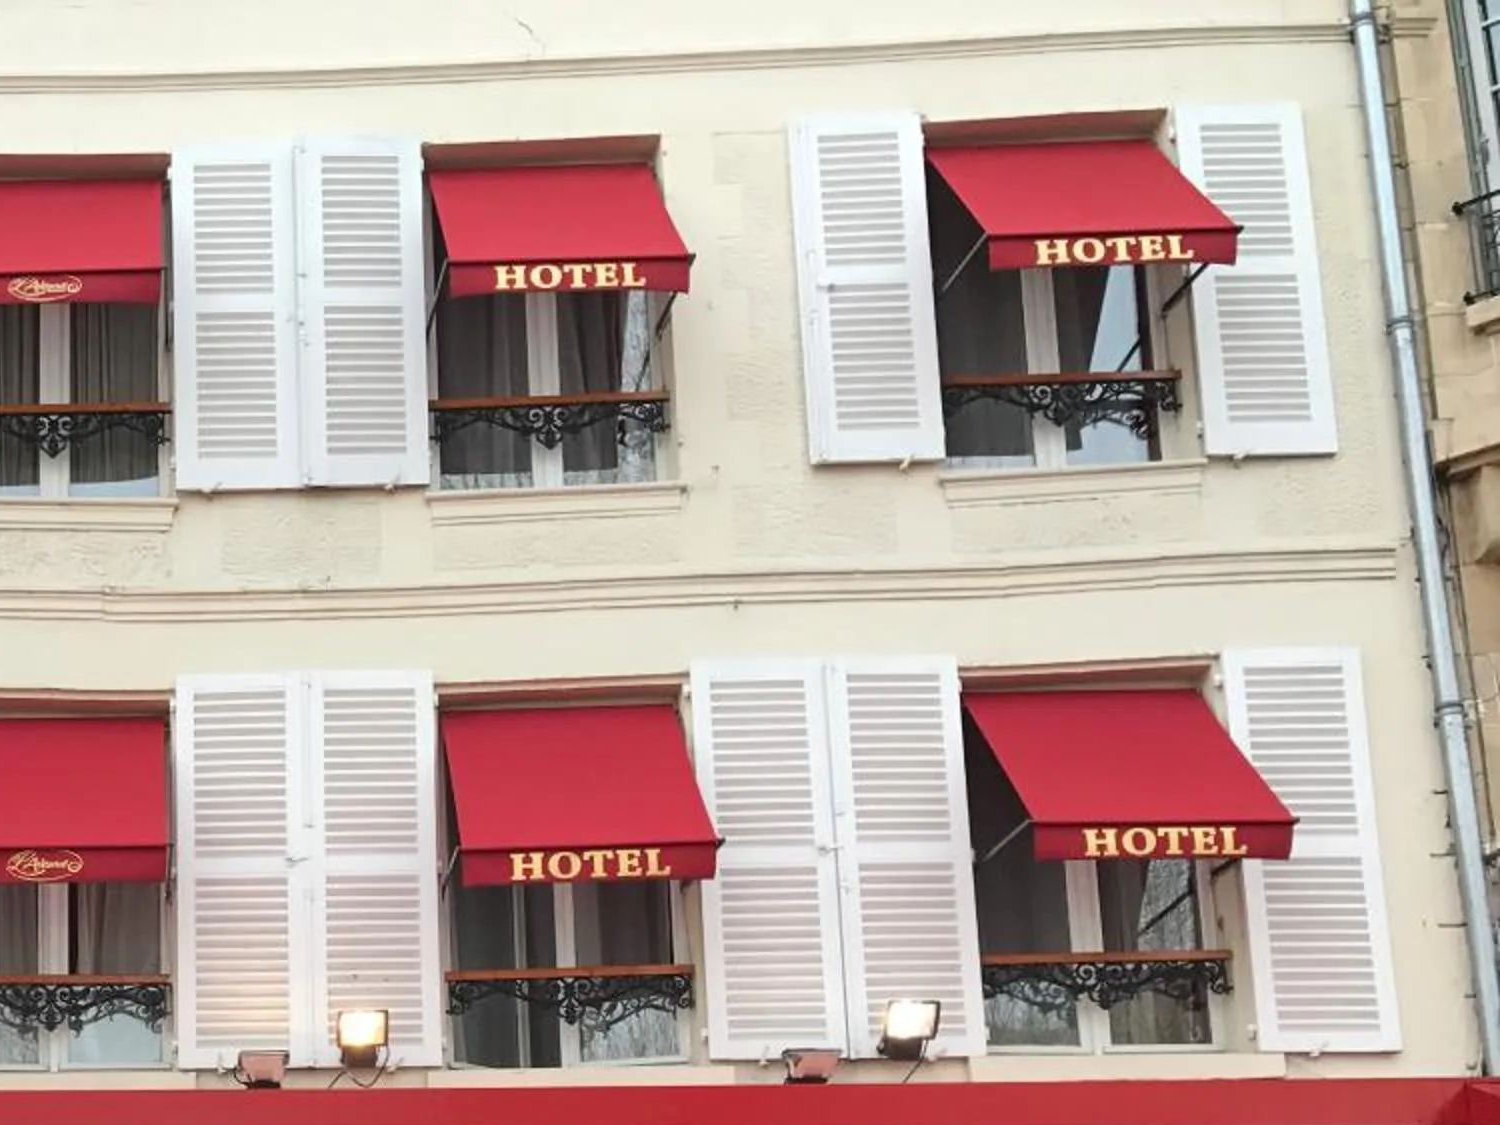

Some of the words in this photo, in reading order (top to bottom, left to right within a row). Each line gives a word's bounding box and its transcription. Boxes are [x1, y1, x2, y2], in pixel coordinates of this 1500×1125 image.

[1035, 236, 1194, 265] HOTEL
[495, 263, 647, 289] HOTEL
[1084, 827, 1248, 857] HOTEL
[511, 849, 671, 880] HOTEL
